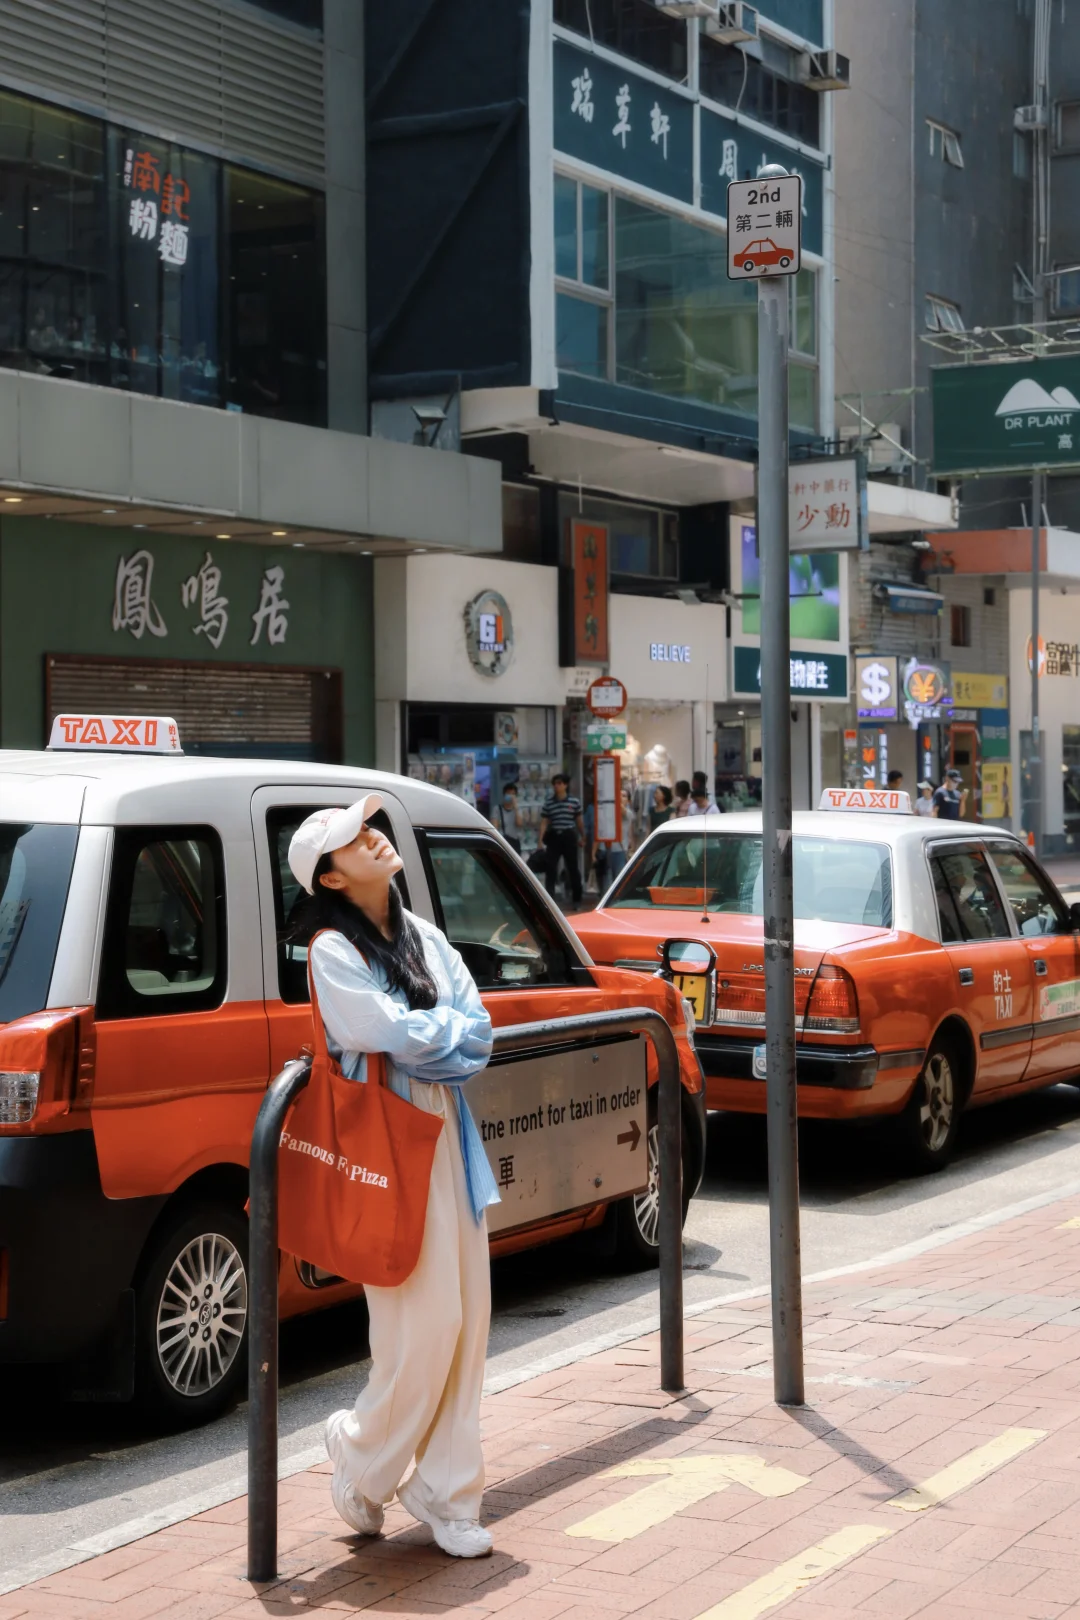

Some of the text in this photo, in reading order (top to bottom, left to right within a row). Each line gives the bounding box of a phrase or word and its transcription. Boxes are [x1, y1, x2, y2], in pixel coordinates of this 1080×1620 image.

[132, 151, 190, 222] 南記
[747, 187, 781, 205] 2nd
[736, 210, 793, 232] 第二輛
[1004, 413, 1073, 430] DR PLANT
[112, 550, 290, 649] 鳳鳴居
[650, 643, 692, 664] BELIEVE
[60, 717, 158, 746] TAXI
[829, 790, 899, 809] TAXI
[993, 969, 1012, 992] 的士
[994, 994, 1013, 1020] TAXI
[547, 1103, 566, 1127] for
[569, 1095, 593, 1121] taxi
[596, 1092, 607, 1115] in
[610, 1085, 641, 1111] order
[278, 1131, 335, 1166] Famous
[349, 1164, 389, 1189] Pizza
[498, 1155, 516, 1190] 車
